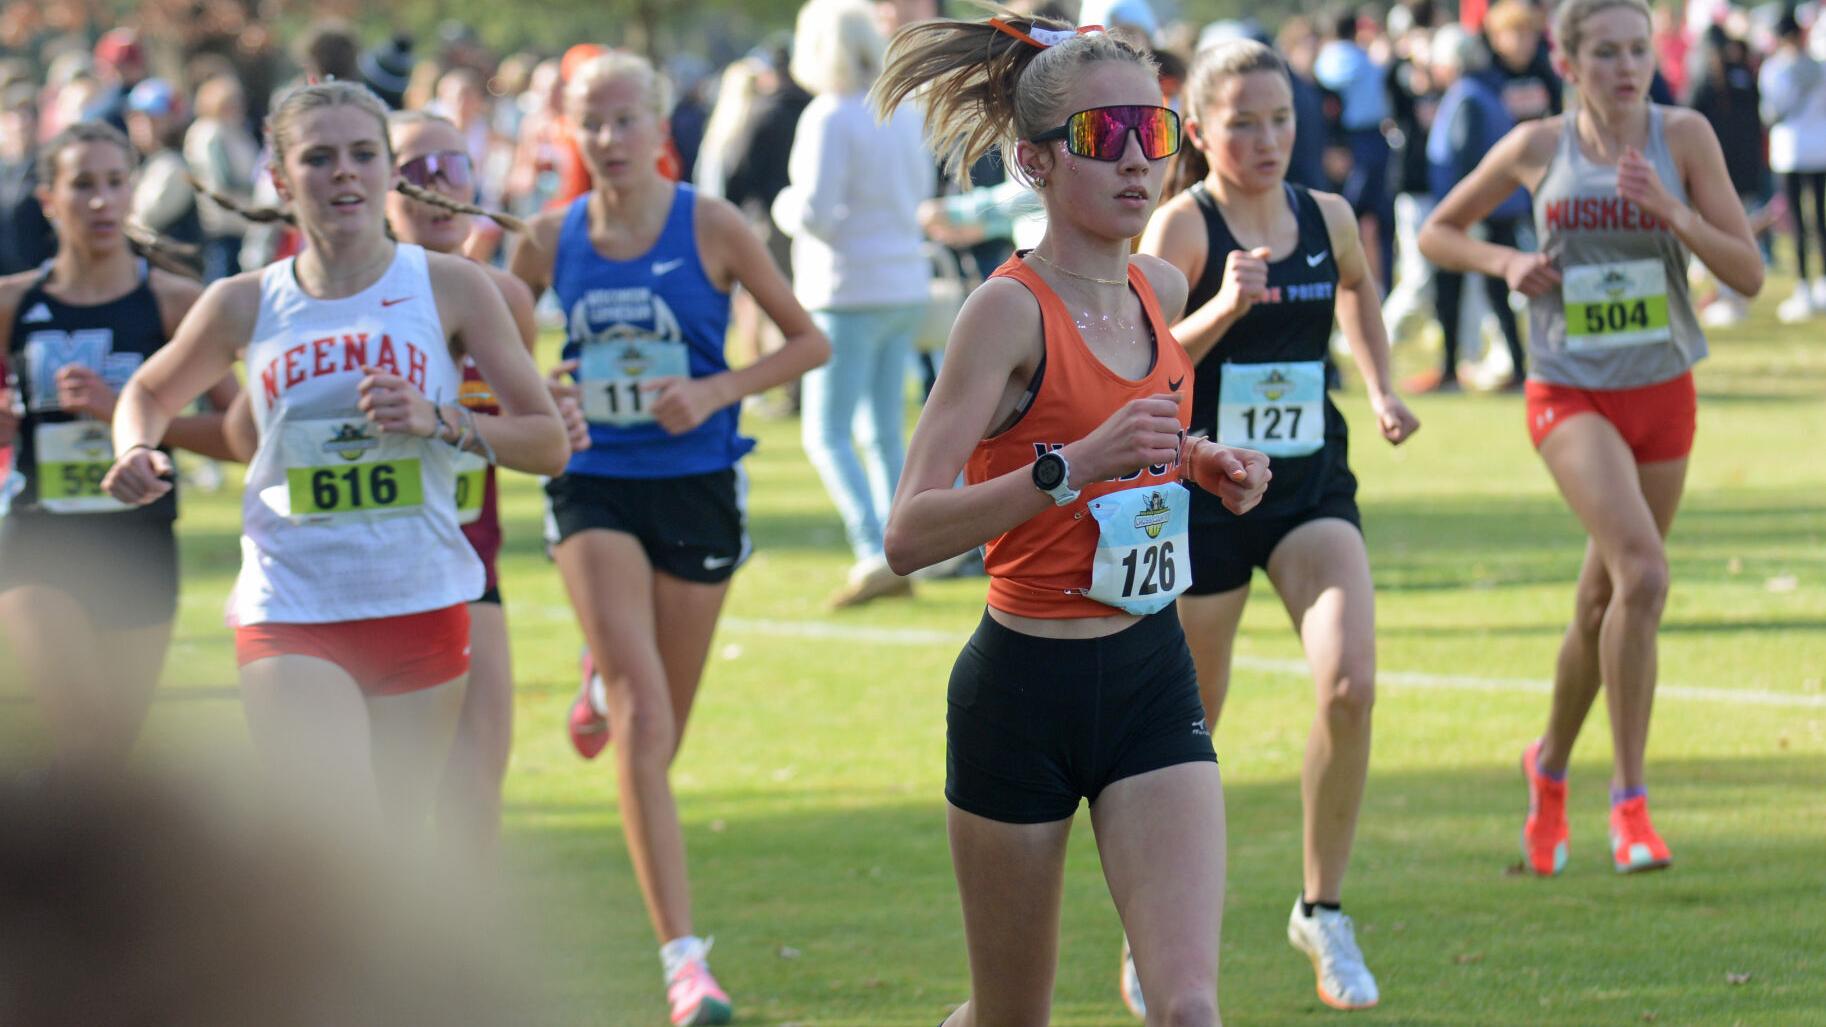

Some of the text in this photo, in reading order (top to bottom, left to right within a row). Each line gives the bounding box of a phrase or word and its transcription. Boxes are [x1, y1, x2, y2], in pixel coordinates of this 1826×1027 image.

[1545, 197, 1668, 231] MUSKEG
[1287, 282, 1332, 302] POINT
[1585, 300, 1648, 334] 504
[260, 333, 428, 411] NEENAH
[605, 382, 641, 413] 11
[1242, 406, 1303, 440] 127
[312, 465, 397, 510] 616
[1121, 541, 1176, 598] 126
